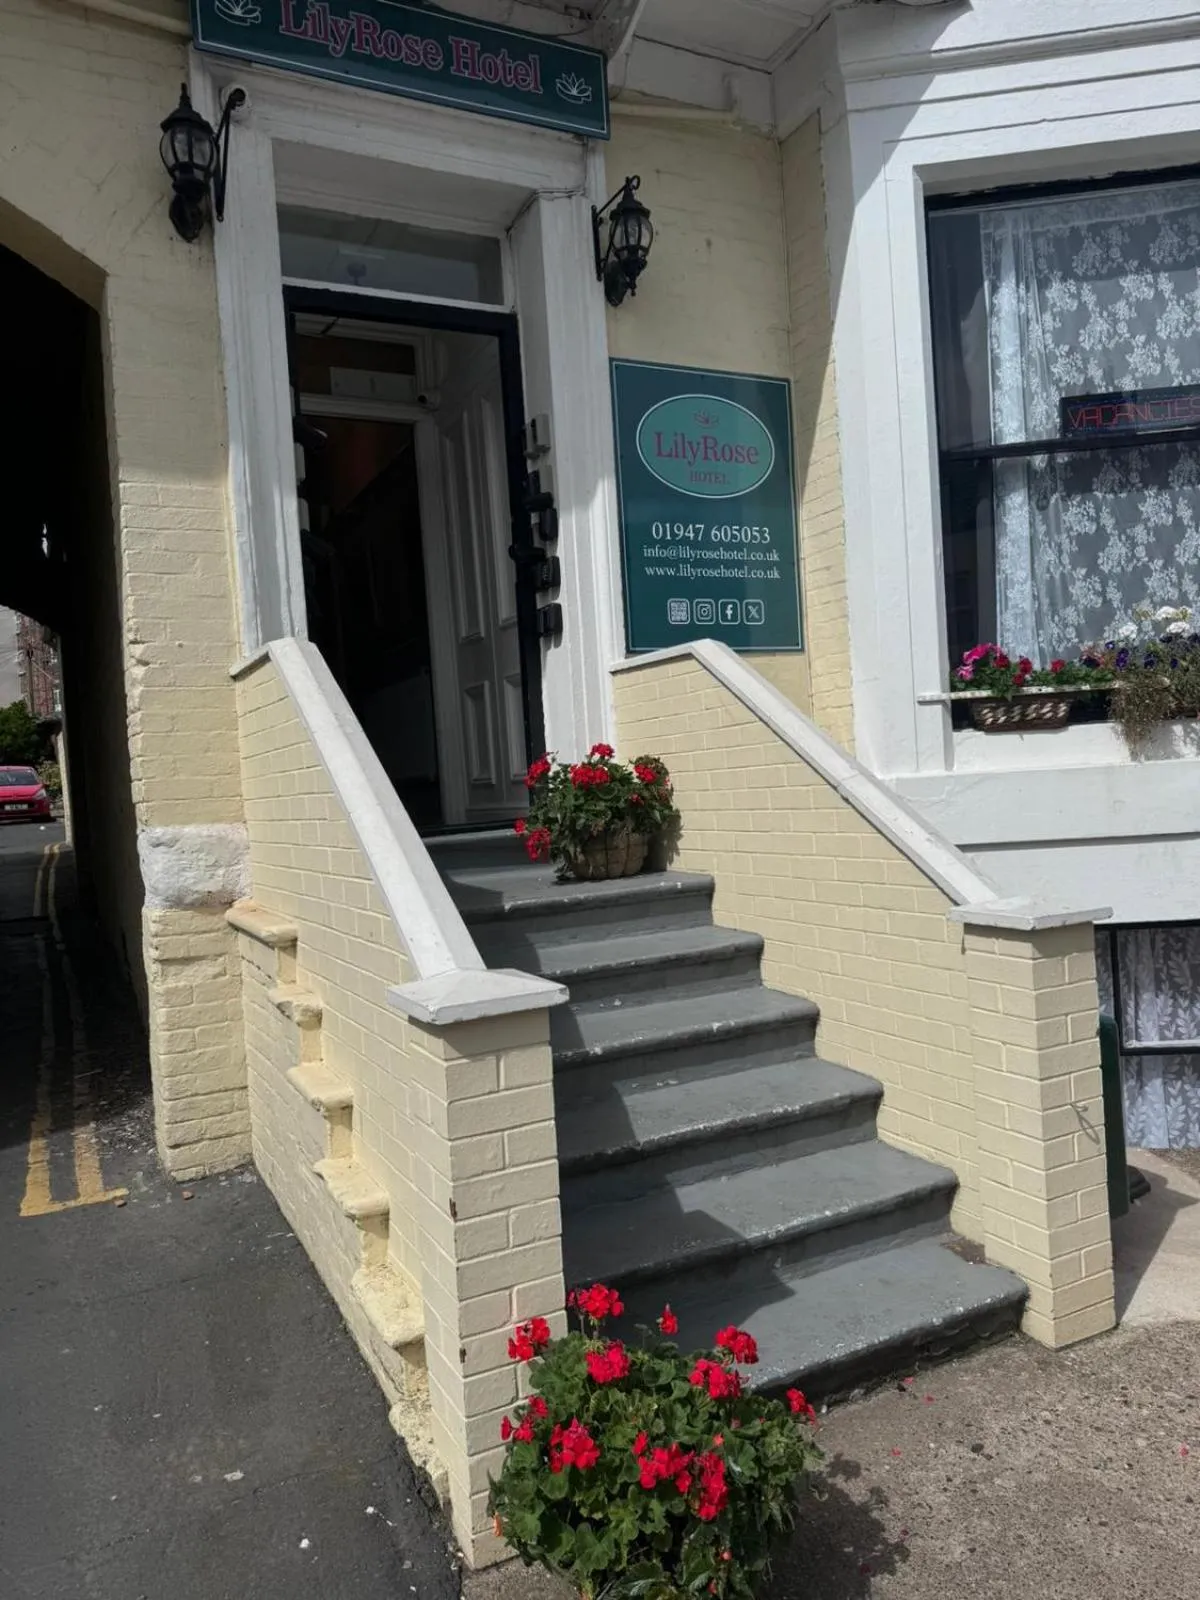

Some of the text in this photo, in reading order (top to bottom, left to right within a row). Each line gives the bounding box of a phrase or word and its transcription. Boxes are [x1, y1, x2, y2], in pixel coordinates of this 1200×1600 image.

[279, 0, 543, 94] LilyRose Hotel
[654, 431, 760, 466] LilyRose
[689, 471, 729, 486] HOTEL
[652, 521, 771, 544] 01947 605053
[642, 544, 781, 562] info@lilyrosehotel.co.uk
[644, 563, 781, 580] www.lilyrosehotel.co.uk
